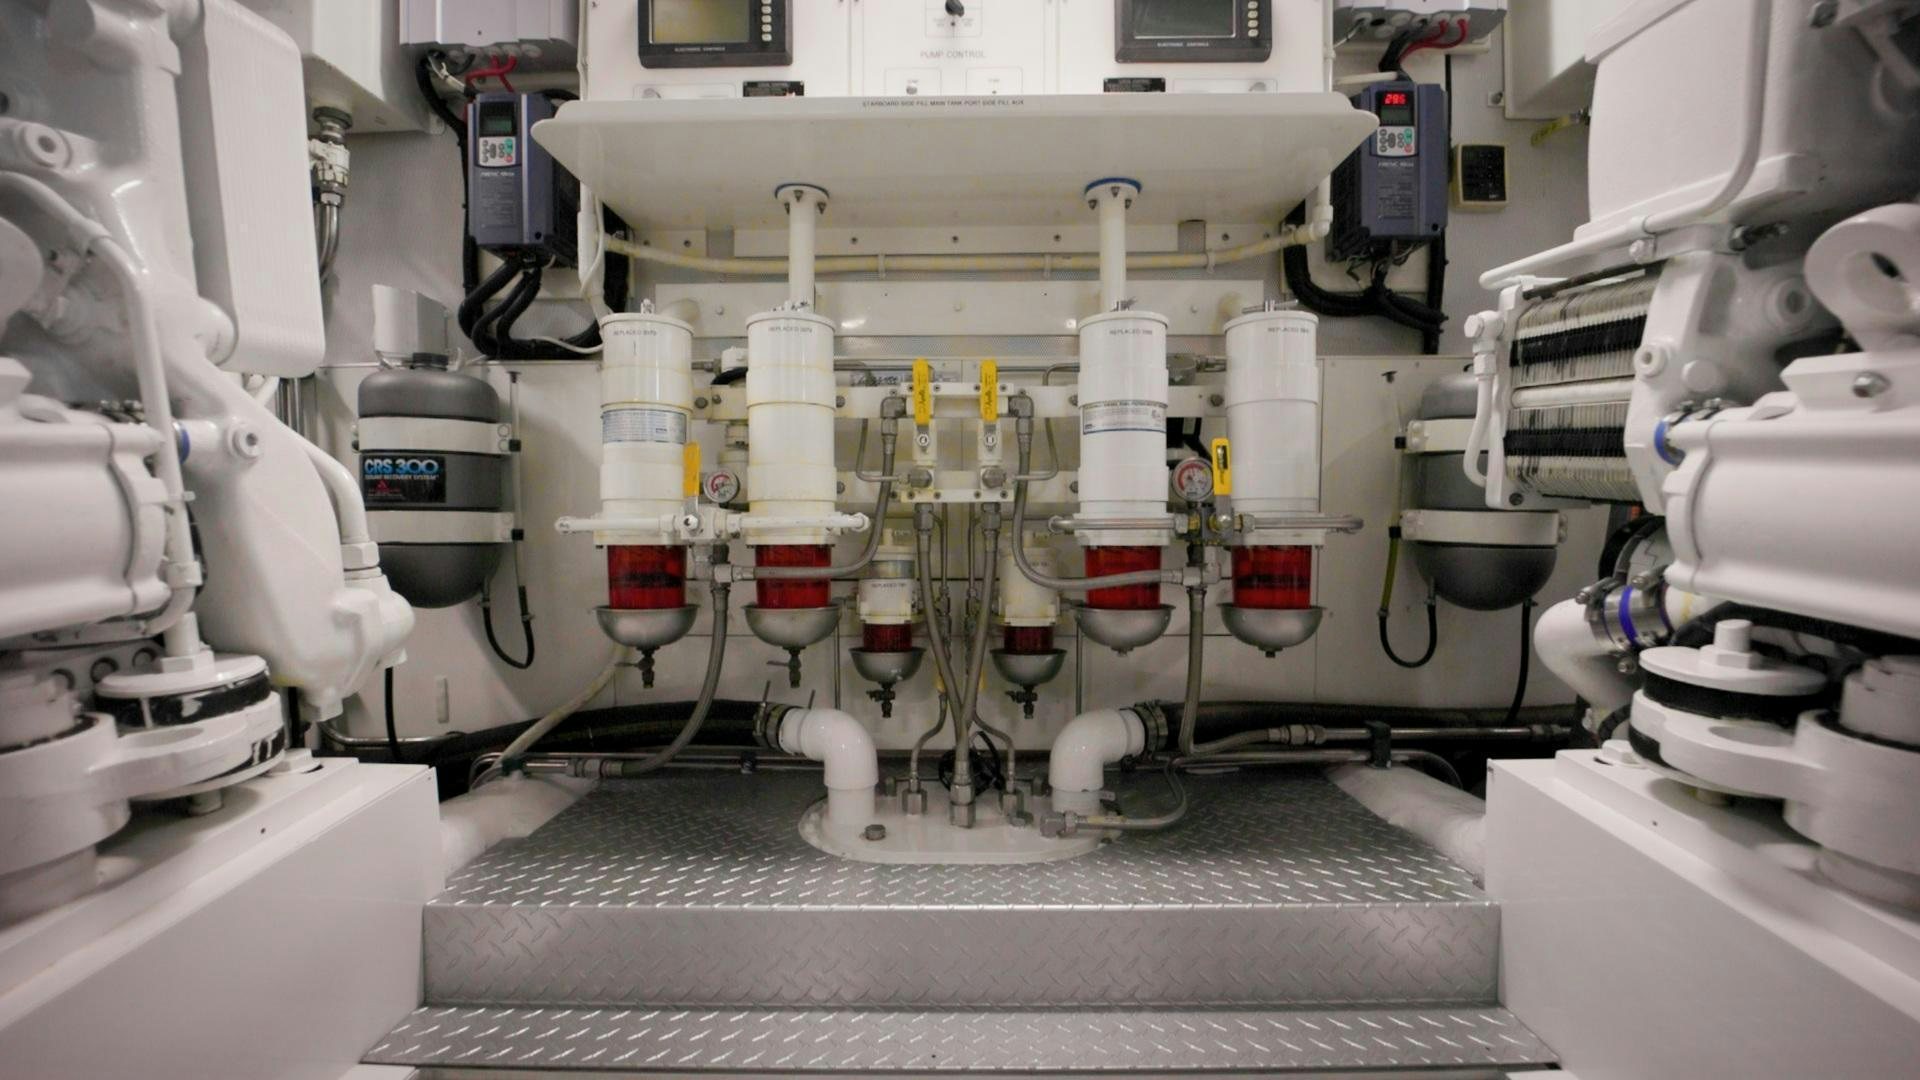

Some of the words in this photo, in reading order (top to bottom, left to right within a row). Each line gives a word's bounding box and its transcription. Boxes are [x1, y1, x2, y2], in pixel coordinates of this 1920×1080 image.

[920, 50, 944, 59] PUMP
[946, 50, 986, 59] CONTROL
[365, 459, 393, 475] CRS
[395, 459, 439, 475] 300
